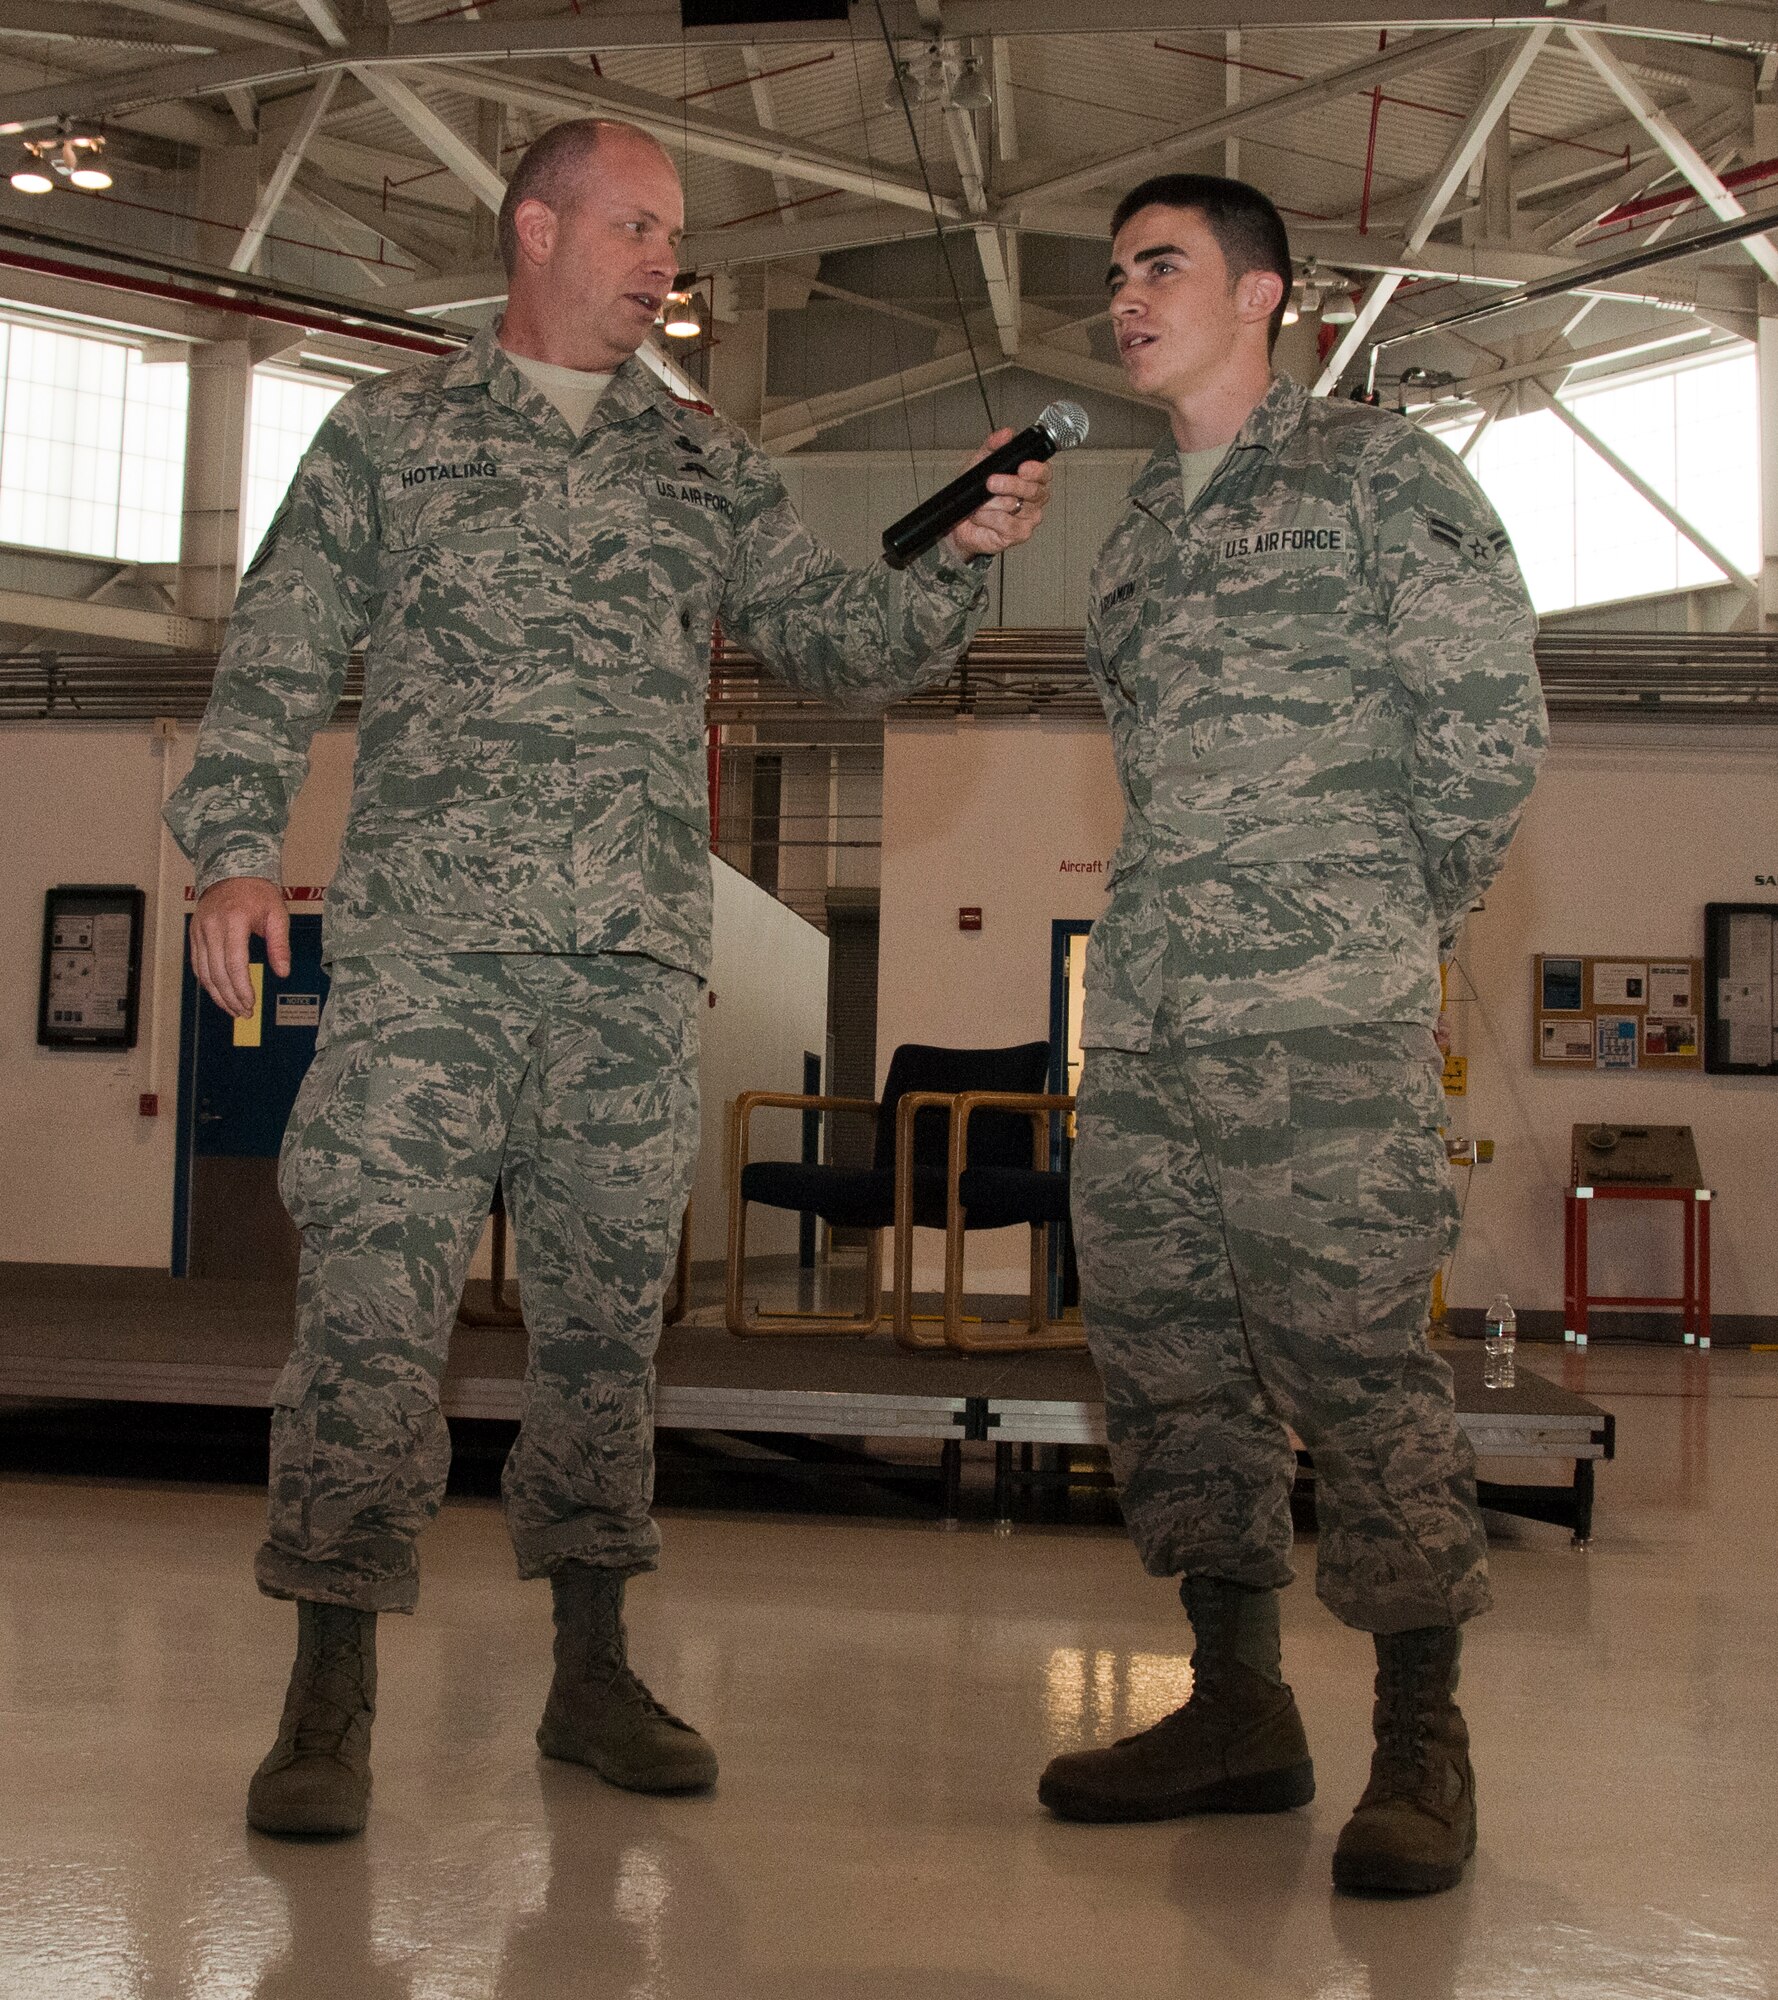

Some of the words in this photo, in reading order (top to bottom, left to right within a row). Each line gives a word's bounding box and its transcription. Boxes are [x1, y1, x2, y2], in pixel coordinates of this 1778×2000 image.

[402, 463, 497, 488] HOTALING
[681, 486, 703, 505] AIR
[704, 492, 735, 517] FORC
[1225, 538, 1251, 558] U.S.
[1255, 532, 1279, 553] AIR
[1281, 529, 1341, 549] FORCE
[1059, 860, 1103, 873] Aircraft
[1754, 875, 1777, 886] SA
